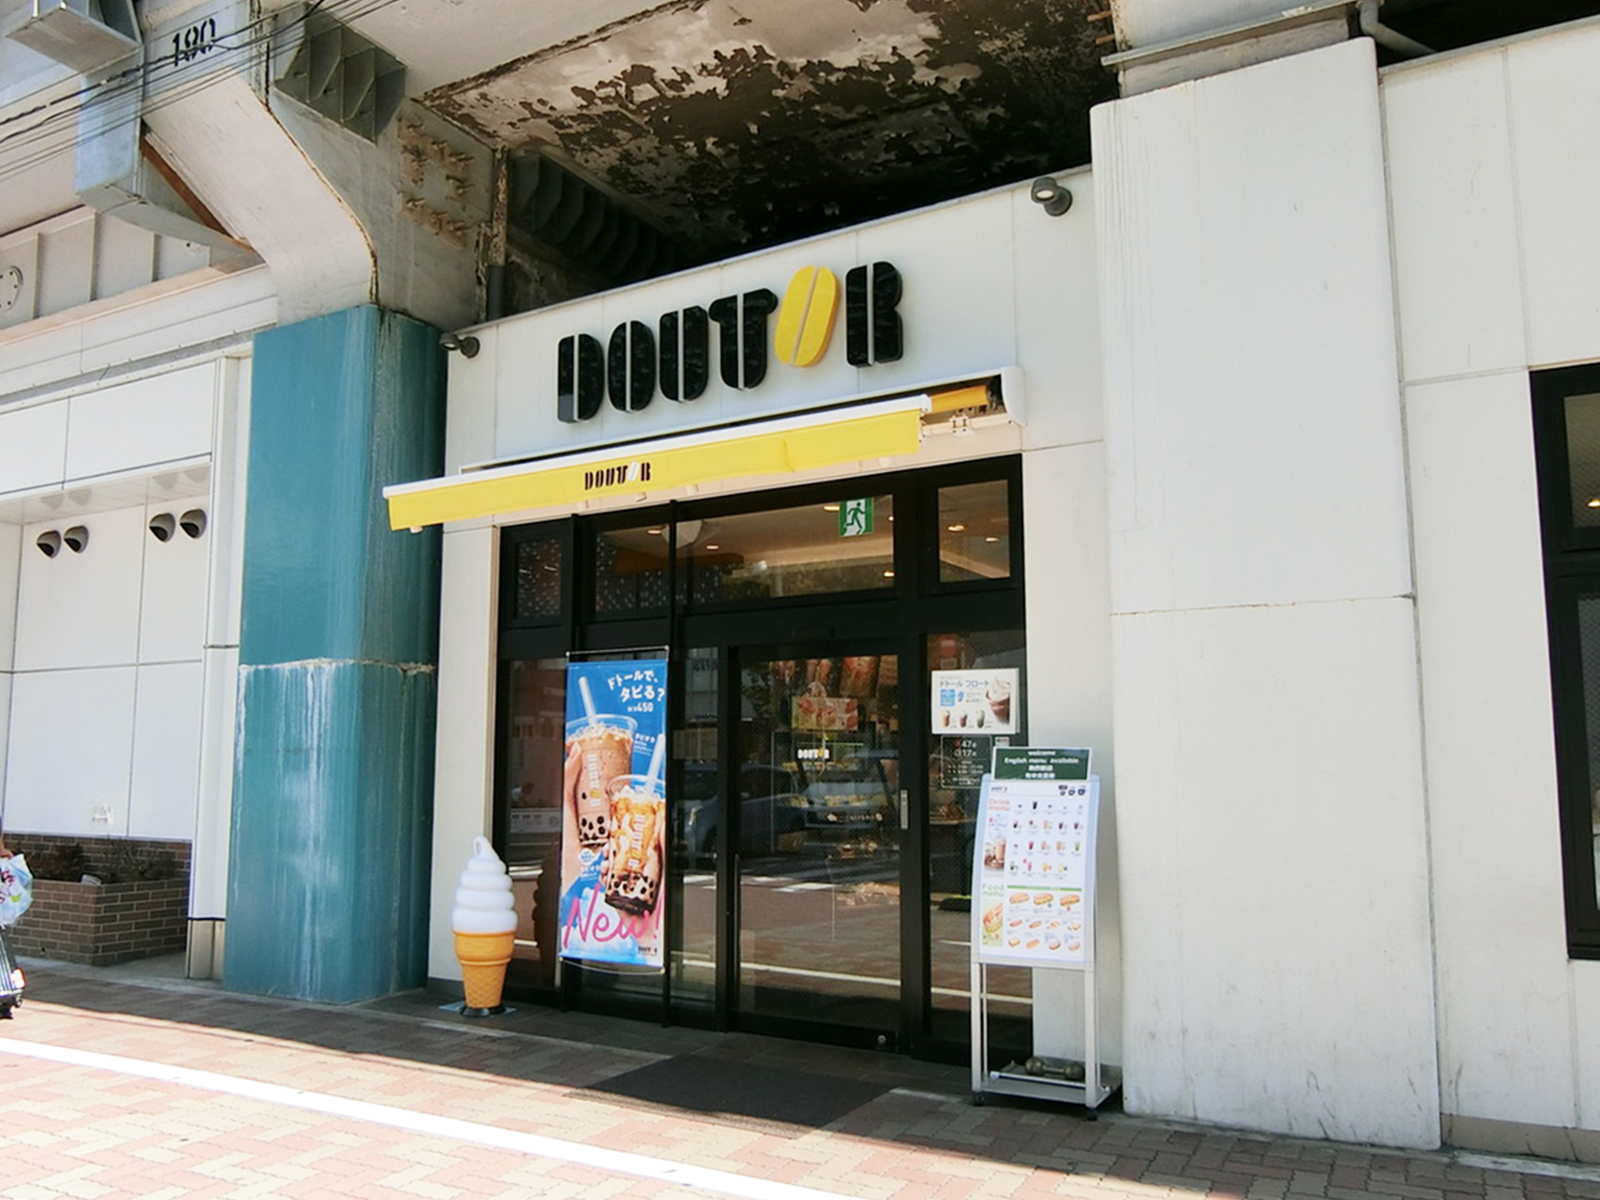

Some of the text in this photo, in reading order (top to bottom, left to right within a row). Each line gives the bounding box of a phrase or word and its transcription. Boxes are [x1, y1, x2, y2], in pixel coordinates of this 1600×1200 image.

[172, 18, 216, 67] 180
[557, 261, 904, 423] DOUTOR
[585, 461, 651, 491] DOUTOR
[607, 670, 659, 690] ドトールで、
[965, 680, 990, 688] フロート
[563, 882, 662, 950] New!
